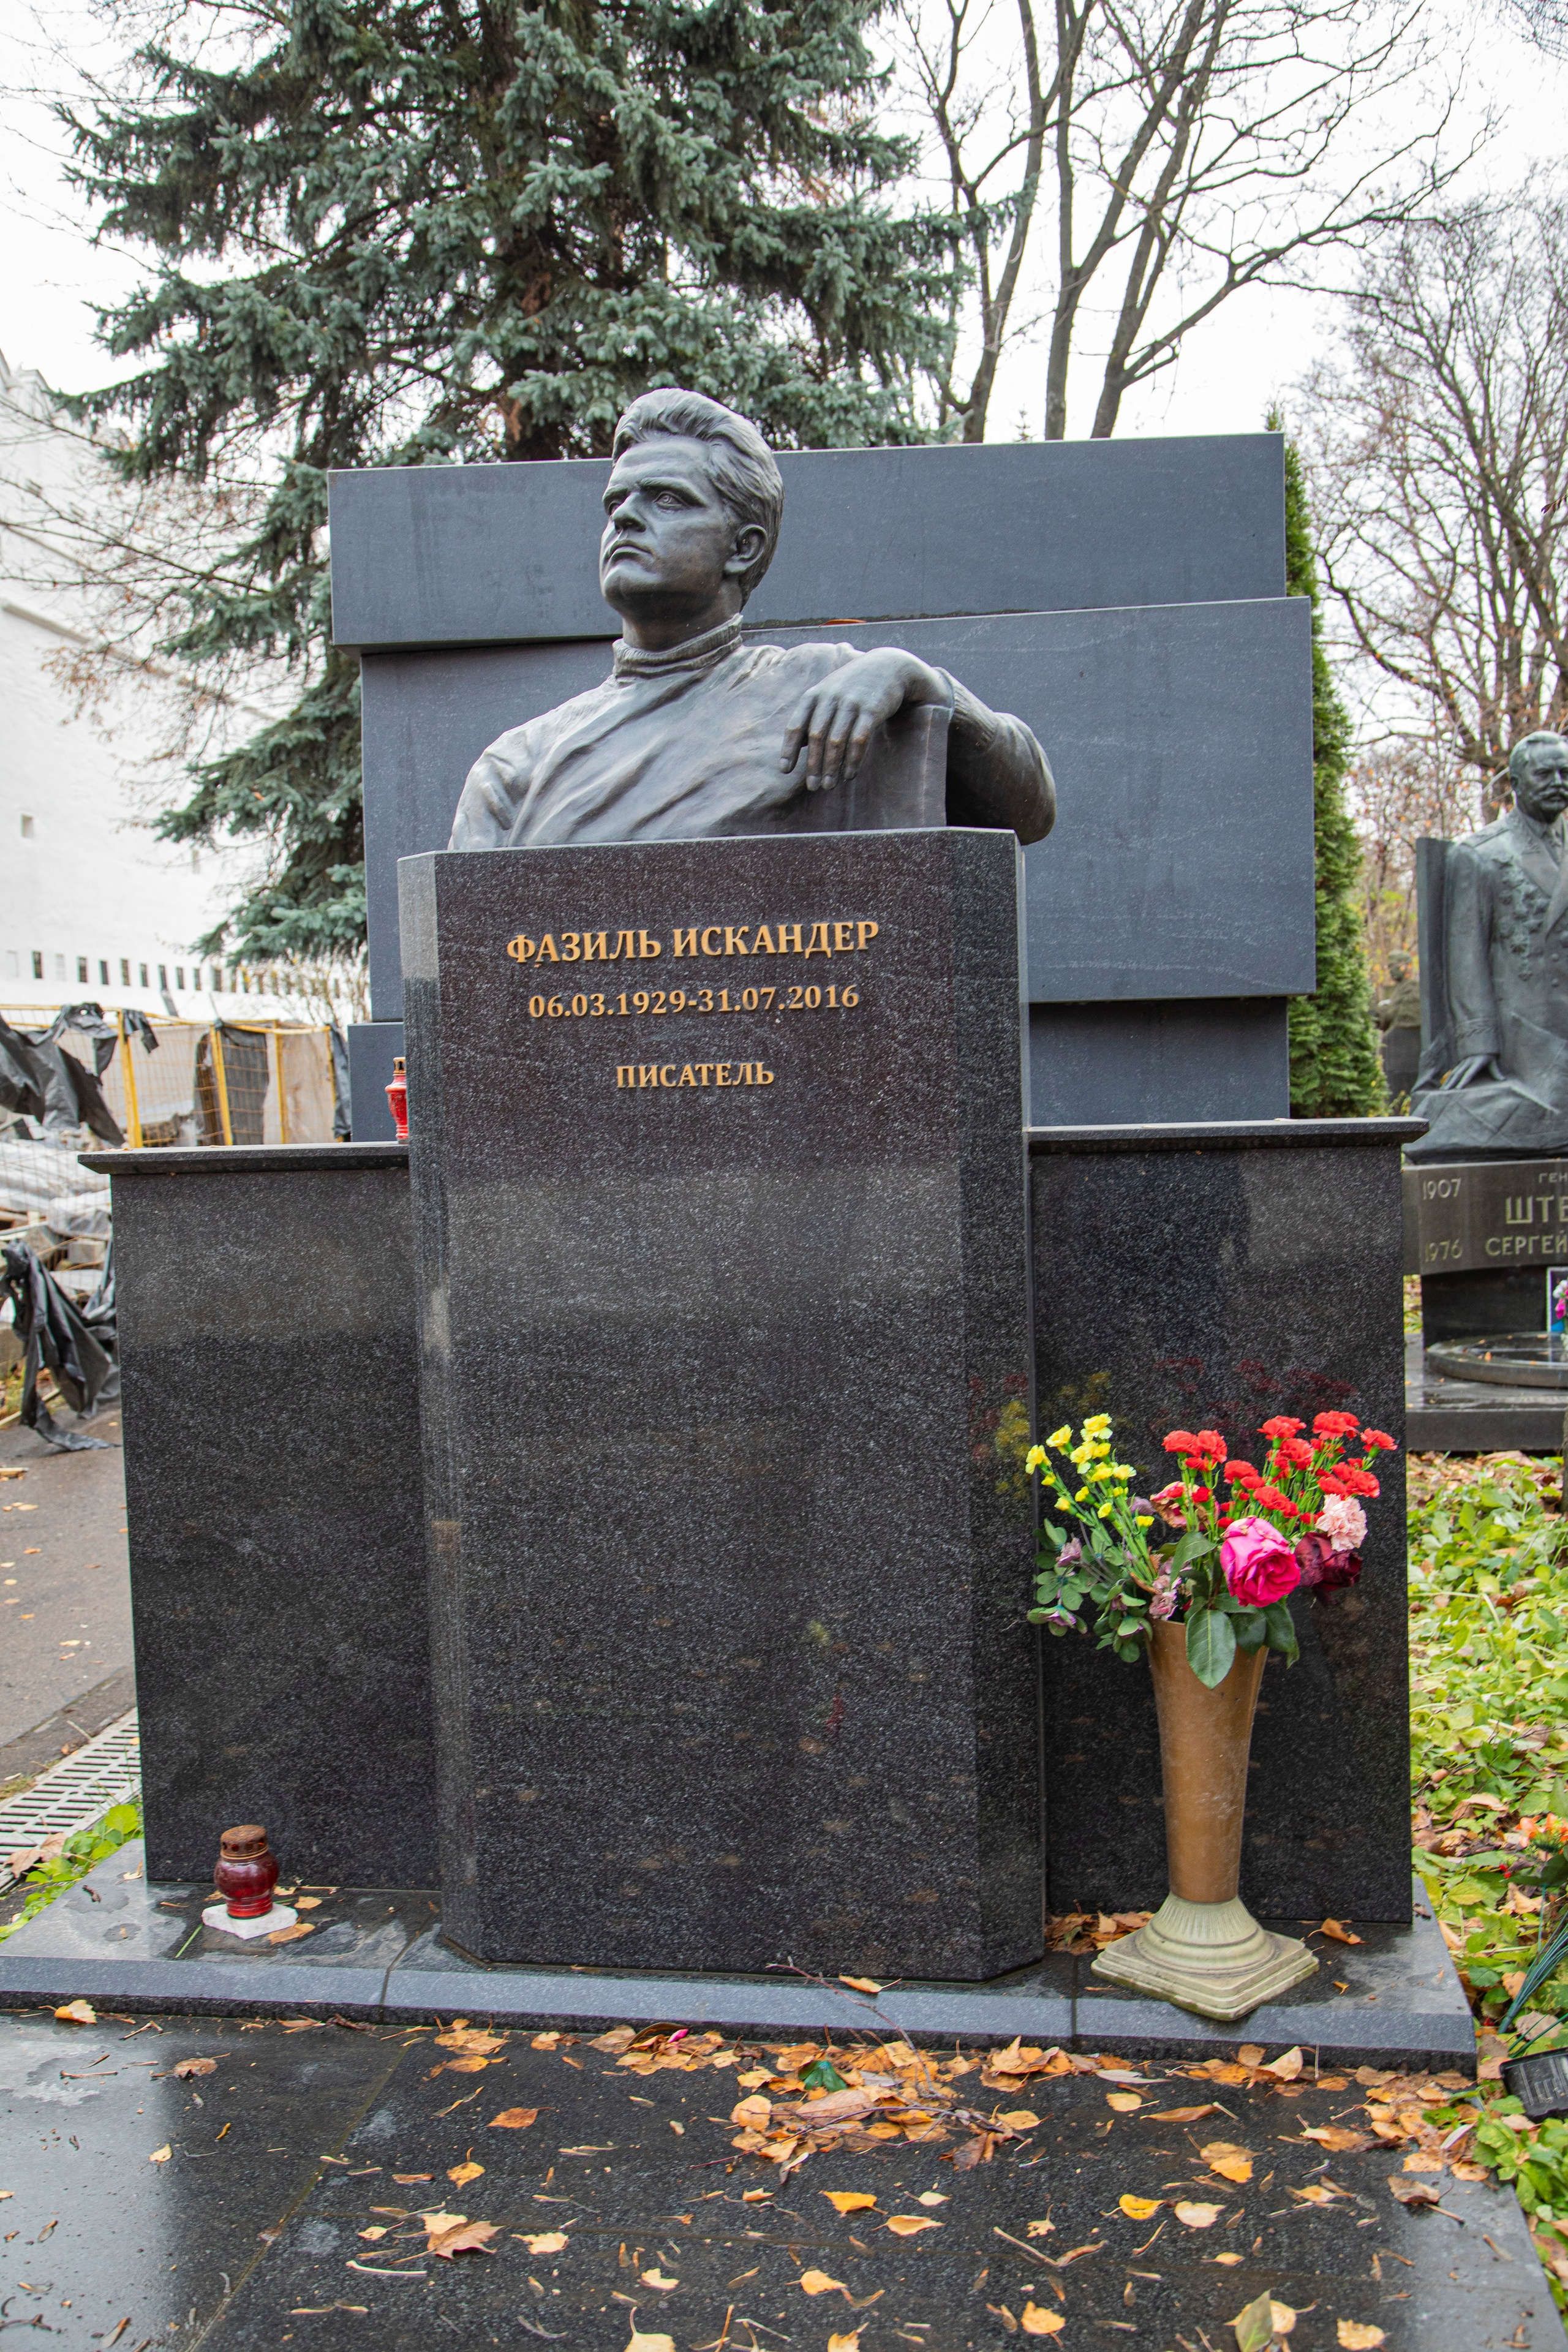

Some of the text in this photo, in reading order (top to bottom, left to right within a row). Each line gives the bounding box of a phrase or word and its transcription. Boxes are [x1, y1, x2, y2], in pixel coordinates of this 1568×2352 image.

[506, 921, 880, 963] ФАЗИЛЬ ИСКАНДЕР
[528, 985, 859, 1018] 06.03.1929-31.07.2016
[616, 1062, 775, 1088] ПИСАТЕЛЬ
[1423, 1178, 1462, 1200] 1907
[1425, 1238, 1464, 1263] 1976
[1485, 1229, 1568, 1256] СЕРГЕЙ
